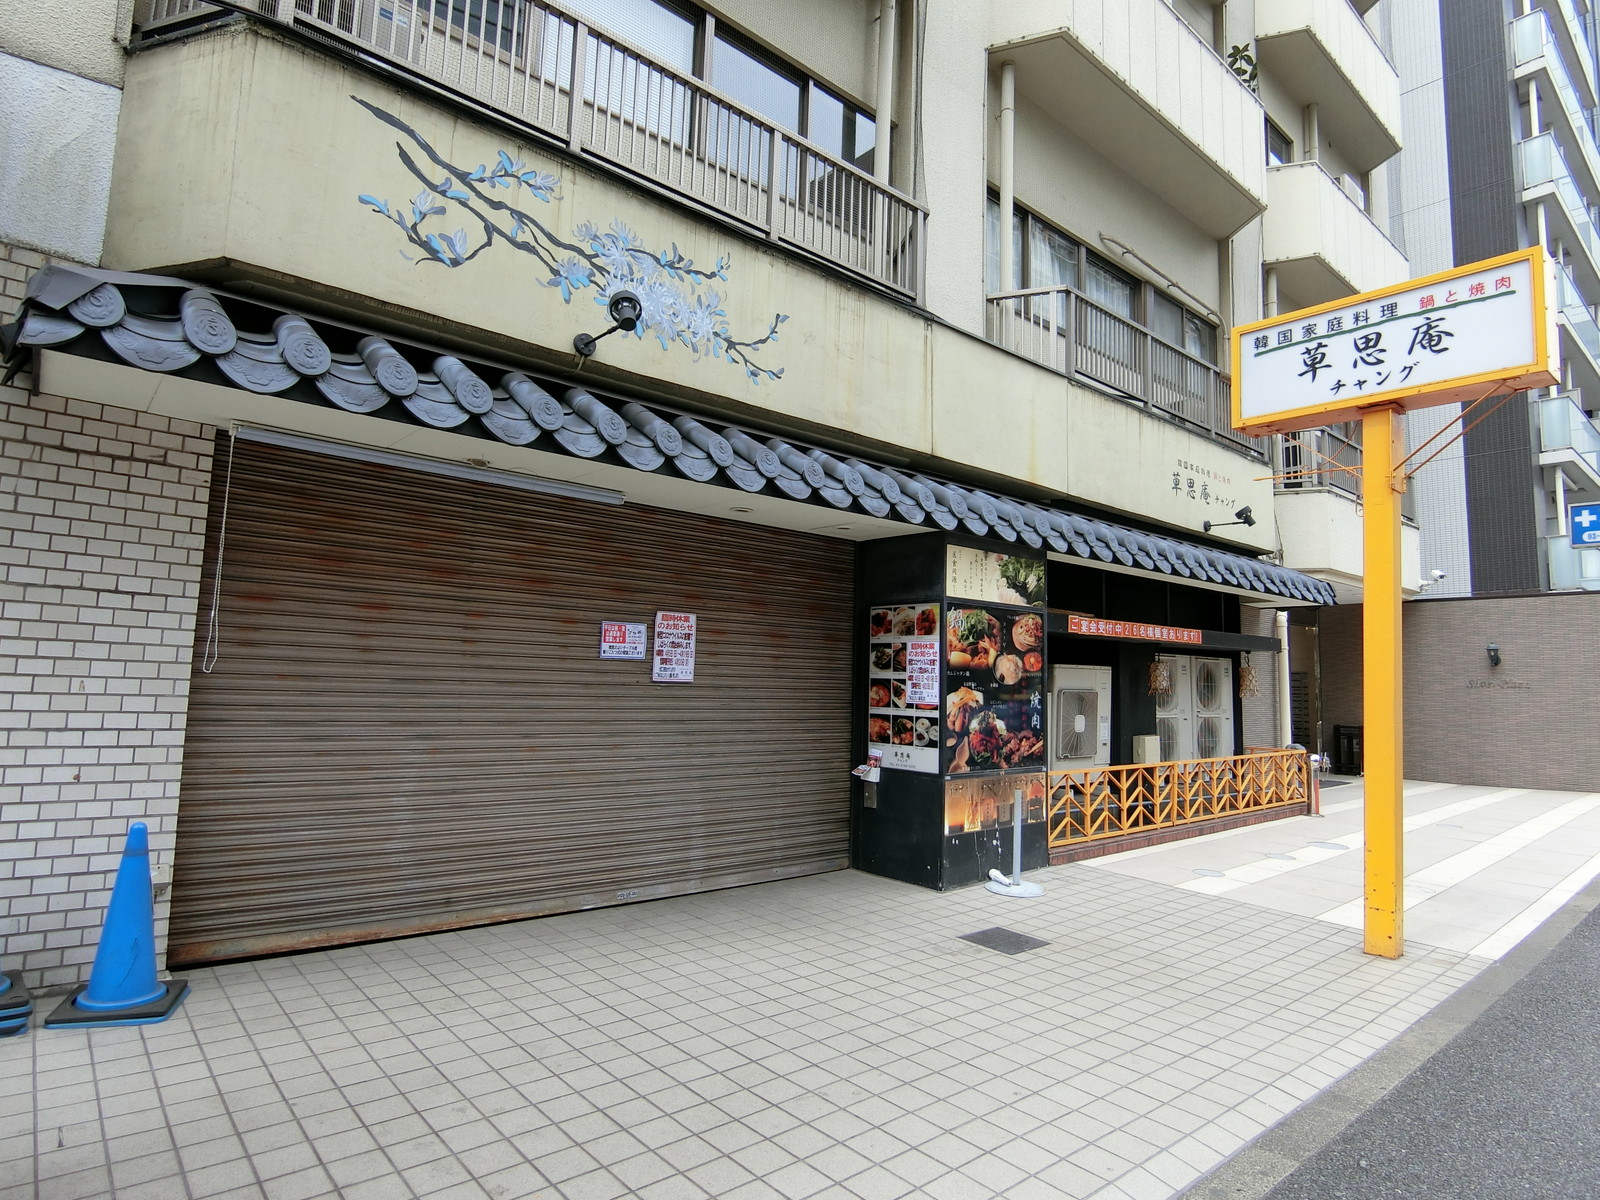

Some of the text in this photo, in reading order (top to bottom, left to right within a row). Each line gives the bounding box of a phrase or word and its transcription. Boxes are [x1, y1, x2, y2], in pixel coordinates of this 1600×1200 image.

[1254, 275, 1512, 351] 韓国家庭料理 鍋と焼肉
[1297, 315, 1455, 383] 草思庵
[1329, 360, 1421, 396] チャング
[1171, 471, 1237, 508] 草思庵 チャング
[657, 622, 694, 631] のお知らせ
[661, 613, 691, 623] 臨時休業
[948, 606, 966, 631] 鍋
[908, 650, 938, 658] のお知らせ
[1029, 690, 1042, 730] 焼肉
